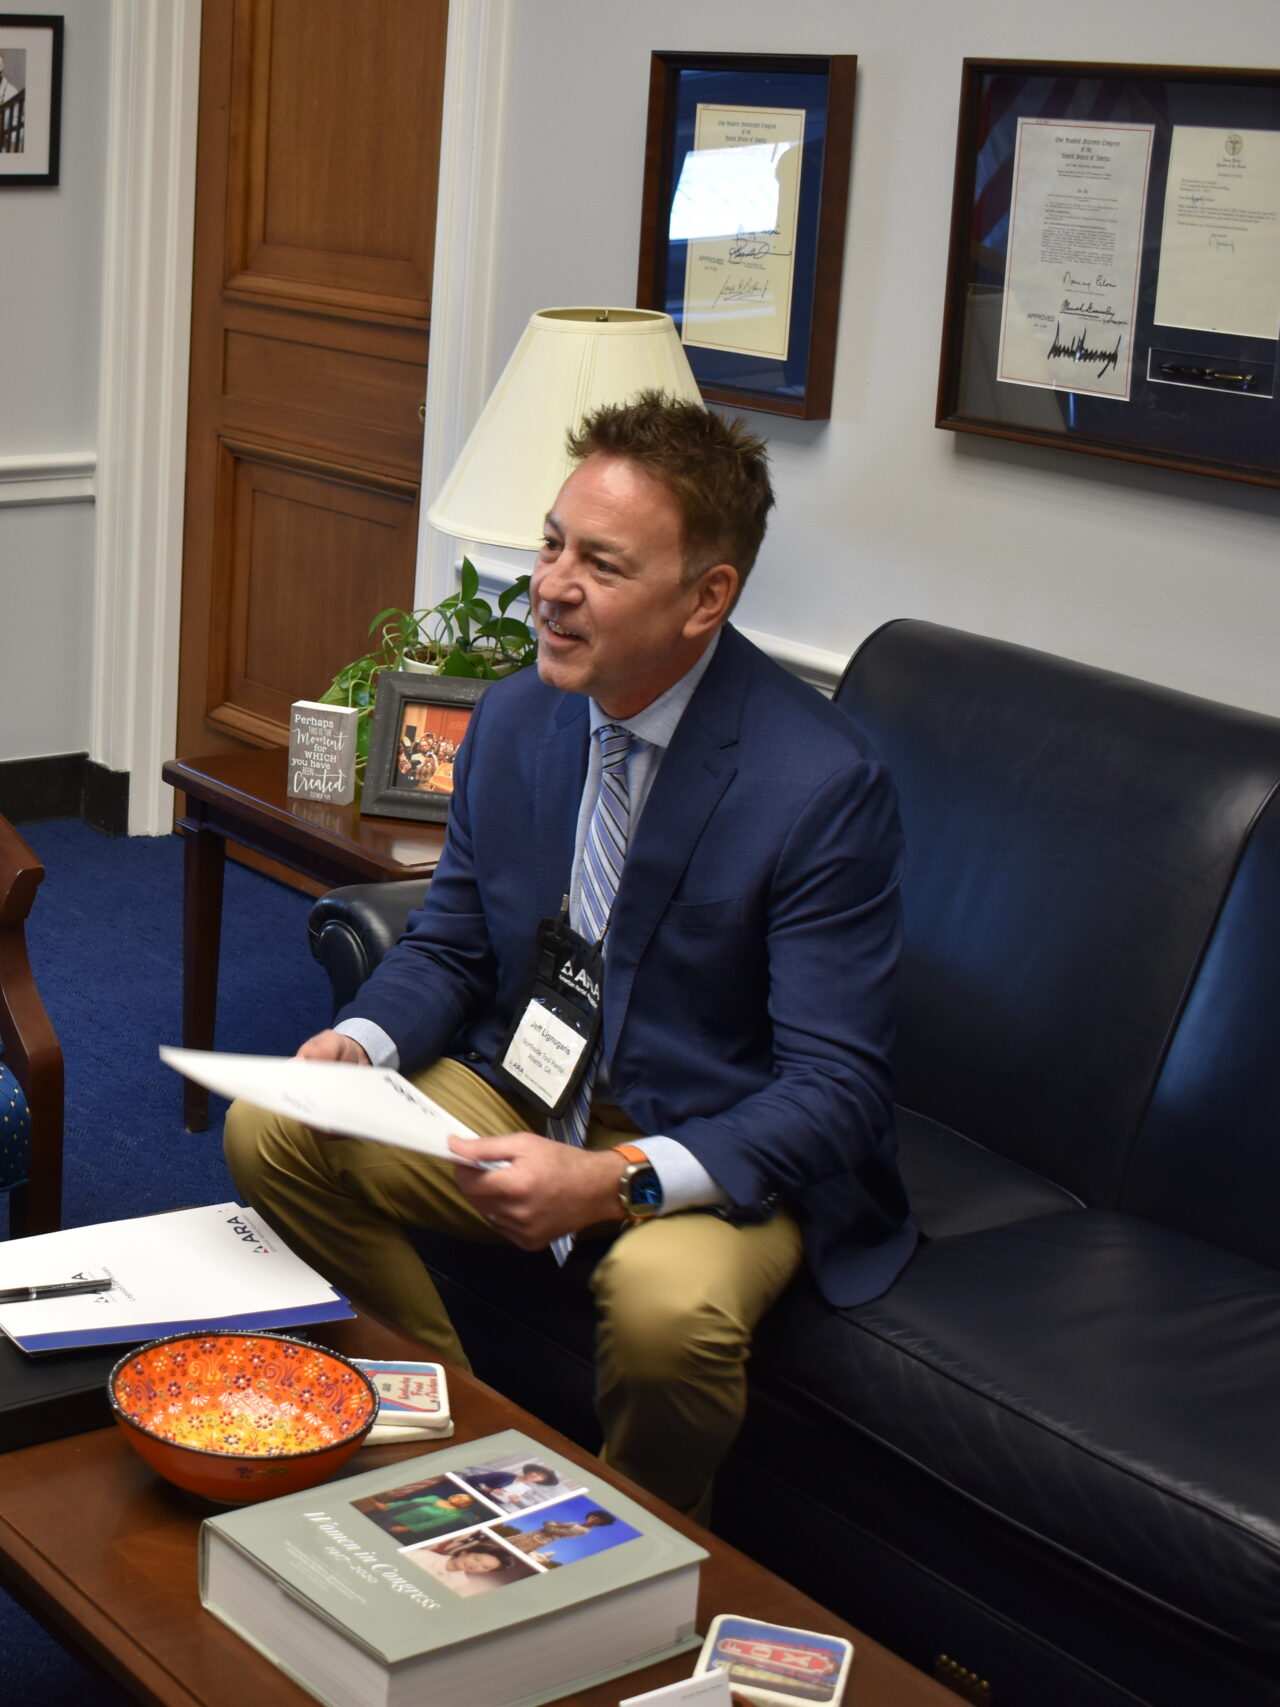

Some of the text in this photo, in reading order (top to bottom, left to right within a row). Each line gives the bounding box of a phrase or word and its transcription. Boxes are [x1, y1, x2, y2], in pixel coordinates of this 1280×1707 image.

[1027, 312, 1055, 322] APPROVED
[294, 714, 334, 729] Perhaps
[292, 728, 348, 751] Moment
[313, 743, 327, 753] for
[291, 757, 331, 770] you have
[304, 750, 337, 763] WHICH
[293, 768, 347, 793] Created
[530, 1020, 543, 1033] Jeff
[226, 1216, 261, 1244] ARA
[302, 1511, 361, 1551] Women
[353, 1550, 378, 1563] in
[370, 1563, 441, 1610] Congress
[726, 1641, 813, 1668] FOX
